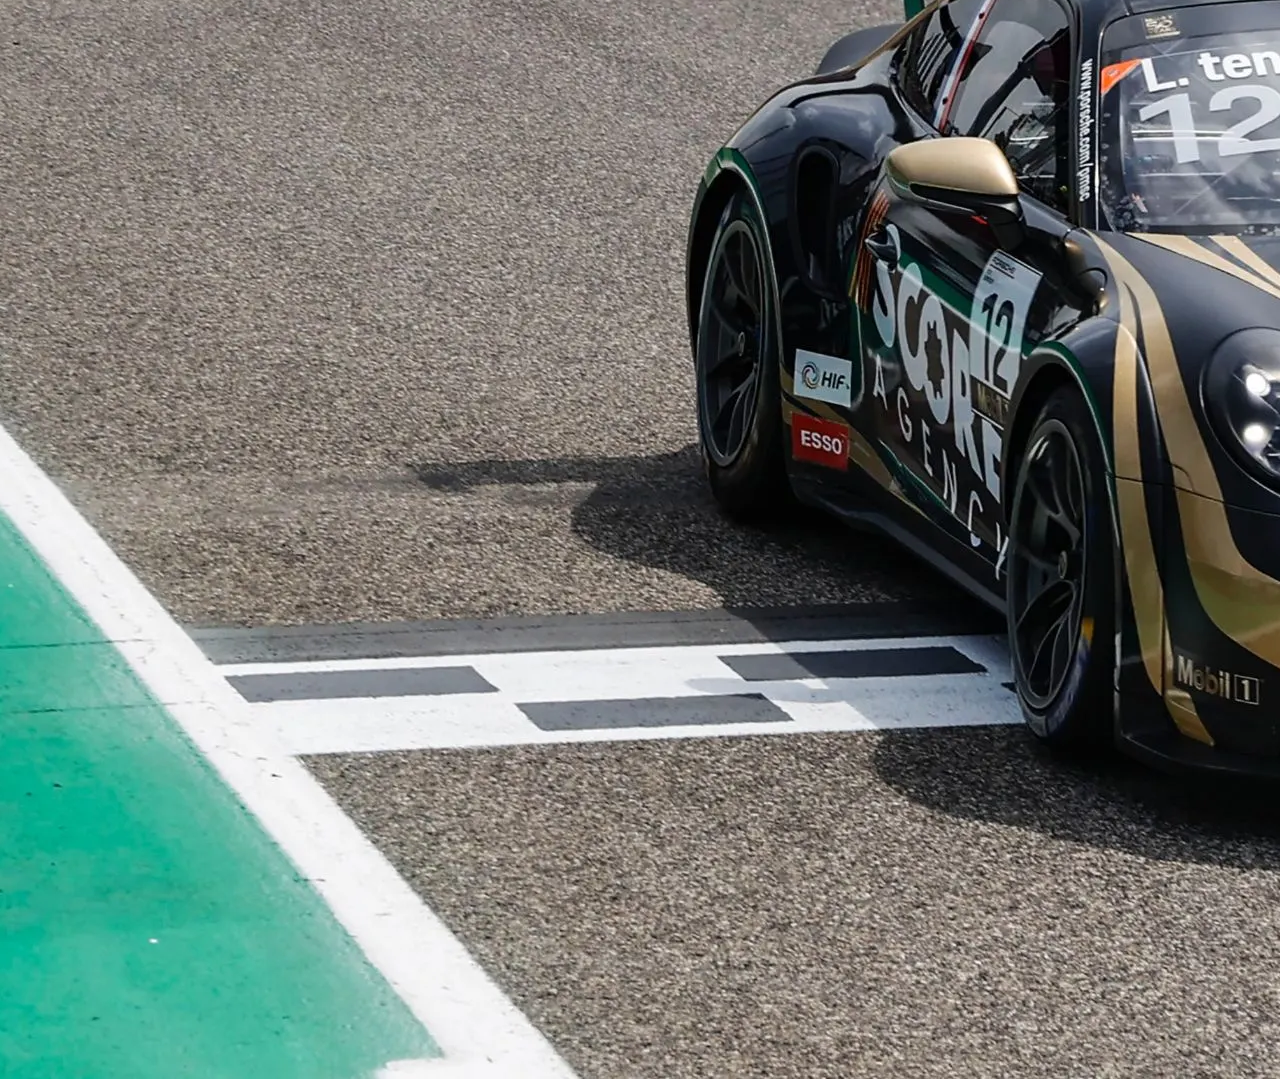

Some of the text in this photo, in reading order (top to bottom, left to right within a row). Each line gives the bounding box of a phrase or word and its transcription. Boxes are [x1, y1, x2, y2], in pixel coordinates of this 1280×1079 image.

[1141, 58, 1189, 93] L.
[1079, 58, 1093, 202] www.porsche.com/pmsc
[982, 293, 1014, 393] 12
[801, 430, 842, 454] ESSO
[1178, 655, 1250, 700] Mobil 1
